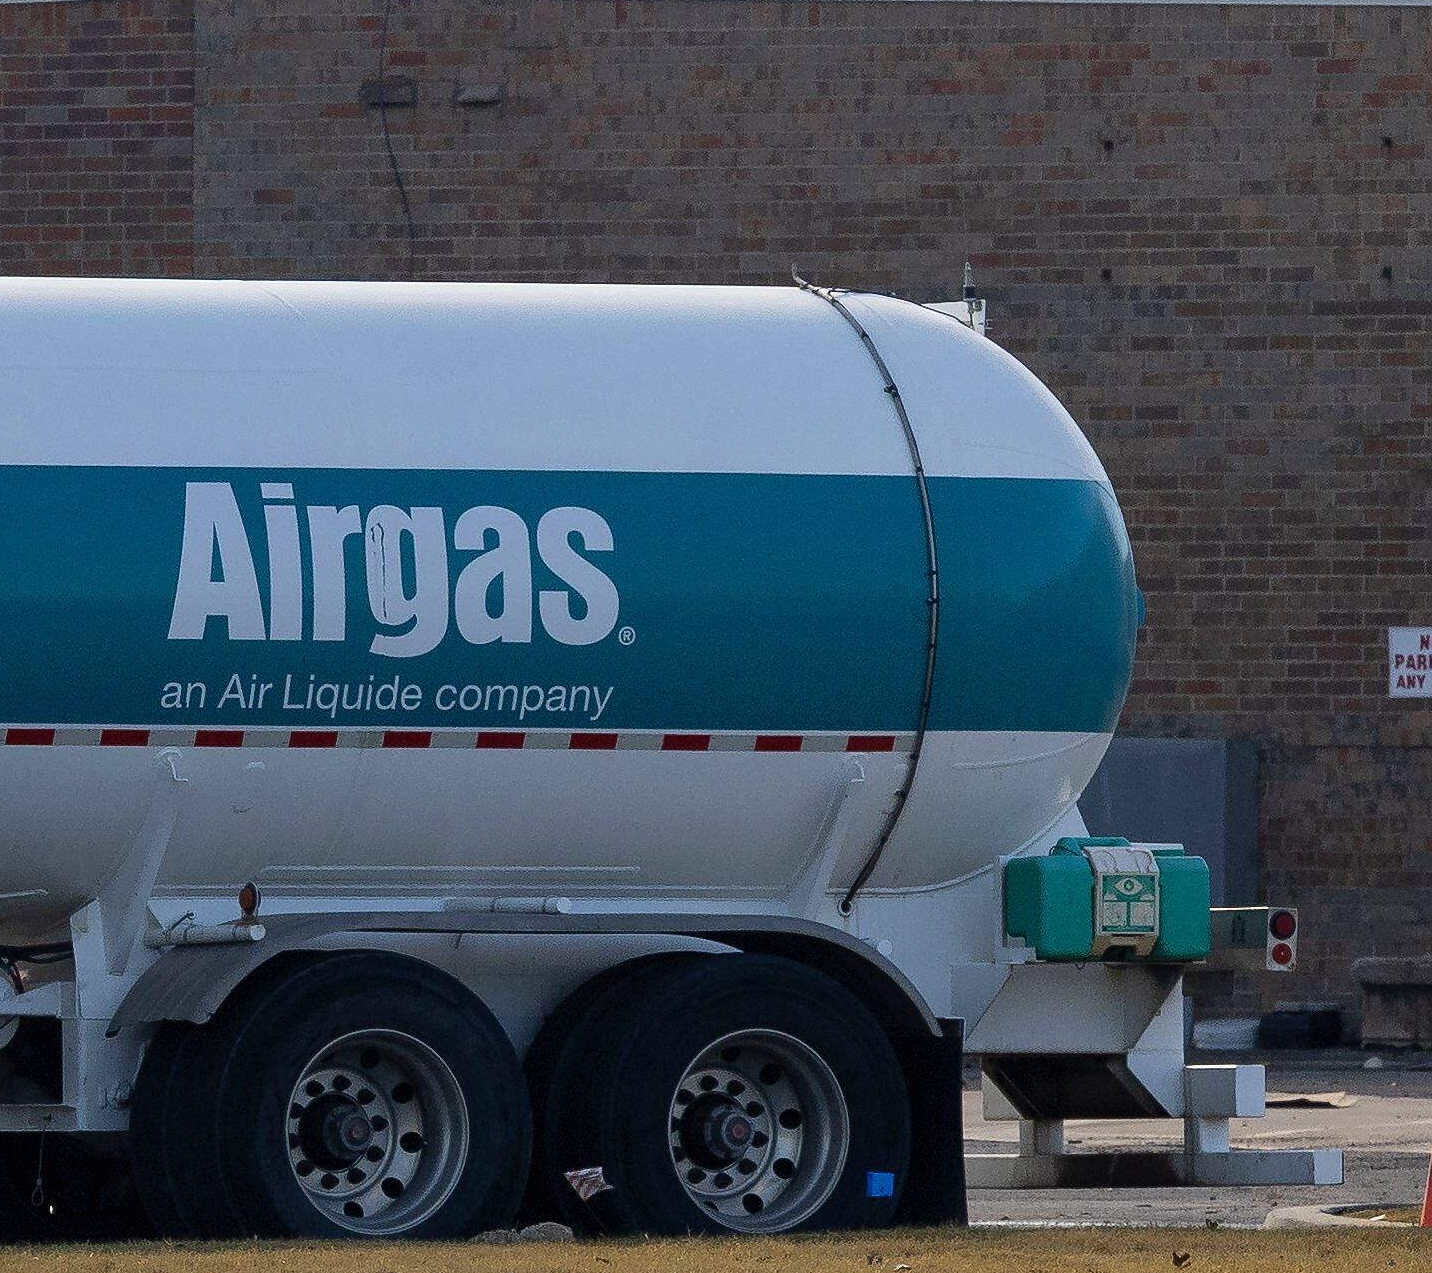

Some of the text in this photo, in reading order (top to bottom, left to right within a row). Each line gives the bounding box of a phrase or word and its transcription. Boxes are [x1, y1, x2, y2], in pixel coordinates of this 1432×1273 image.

[160, 674, 615, 722] an Air Liquide company
